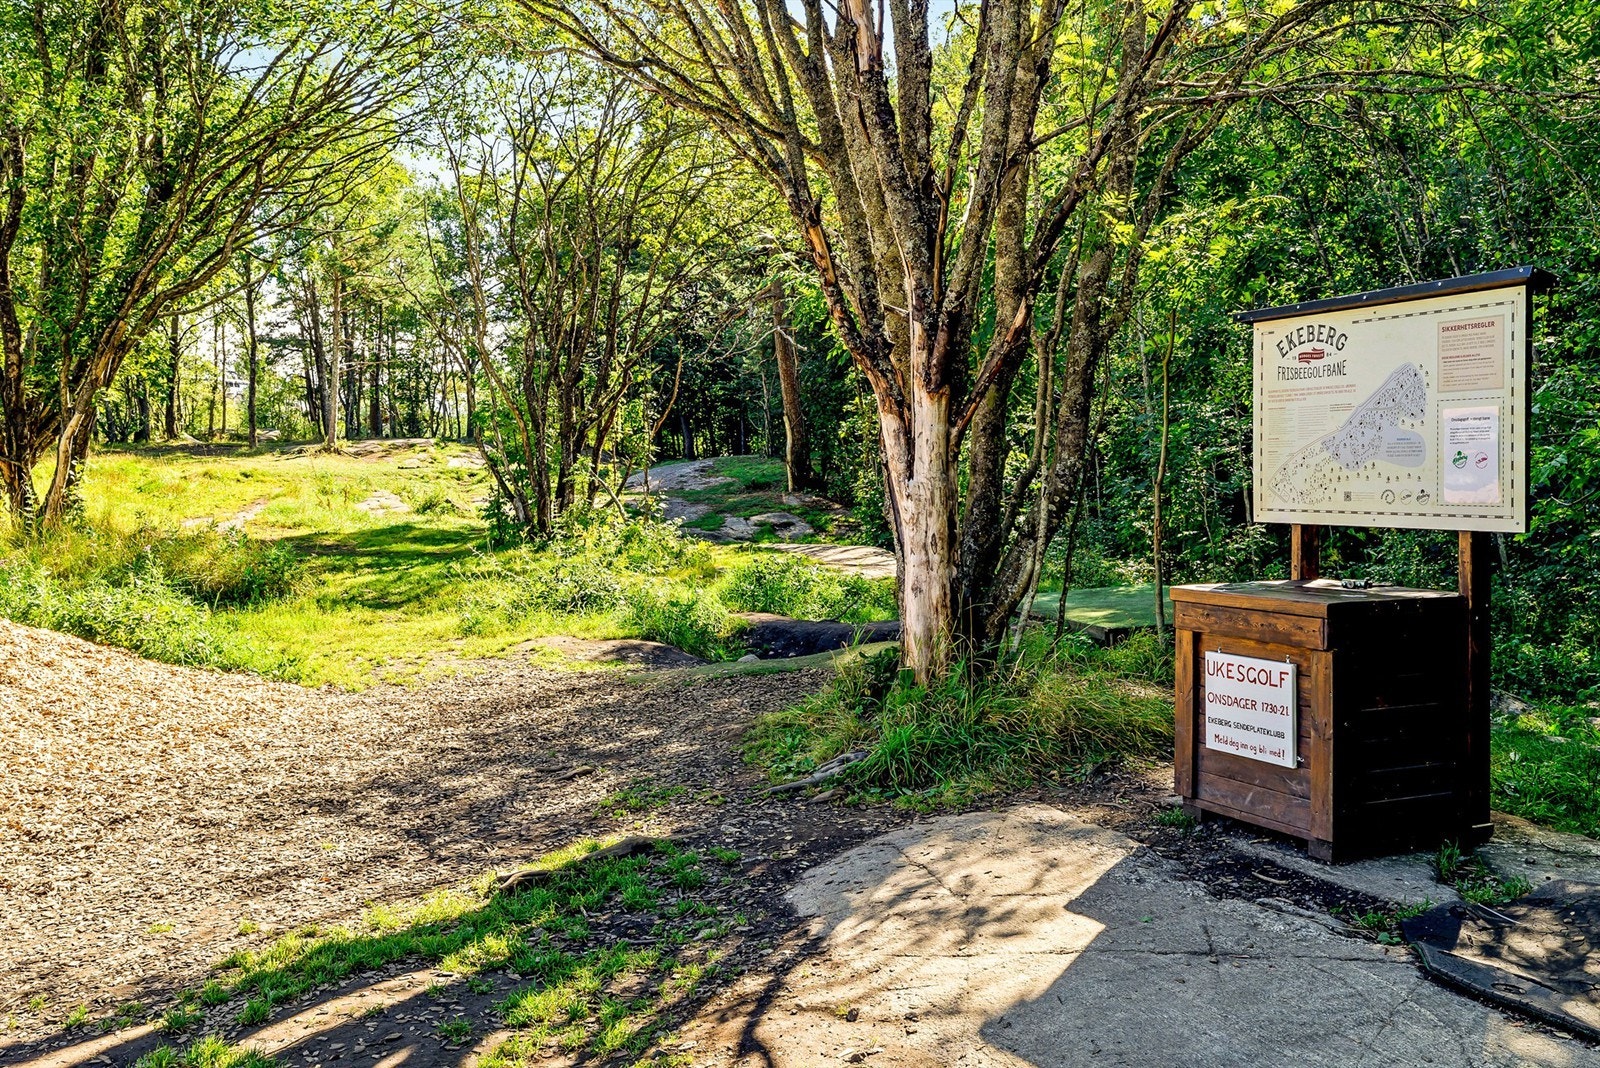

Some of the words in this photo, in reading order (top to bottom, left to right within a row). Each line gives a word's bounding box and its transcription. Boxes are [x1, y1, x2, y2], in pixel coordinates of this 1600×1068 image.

[1441, 321, 1495, 333] SIKKERHETSREGLER
[1276, 324, 1348, 359] EKEBERG
[1277, 359, 1347, 381] FRISBEEGOLFBANE
[1206, 660, 1289, 688] UKESGOLF
[1207, 692, 1257, 711] ONSDAGER
[1207, 716, 1232, 728] EKEBERG
[1233, 721, 1285, 740] SENDEPLATEKLUBB
[1214, 733, 1228, 746] Meld
[1229, 736, 1239, 751] deg
[1240, 740, 1249, 750] inn
[1249, 745, 1257, 755] og
[1258, 744, 1267, 755] bli
